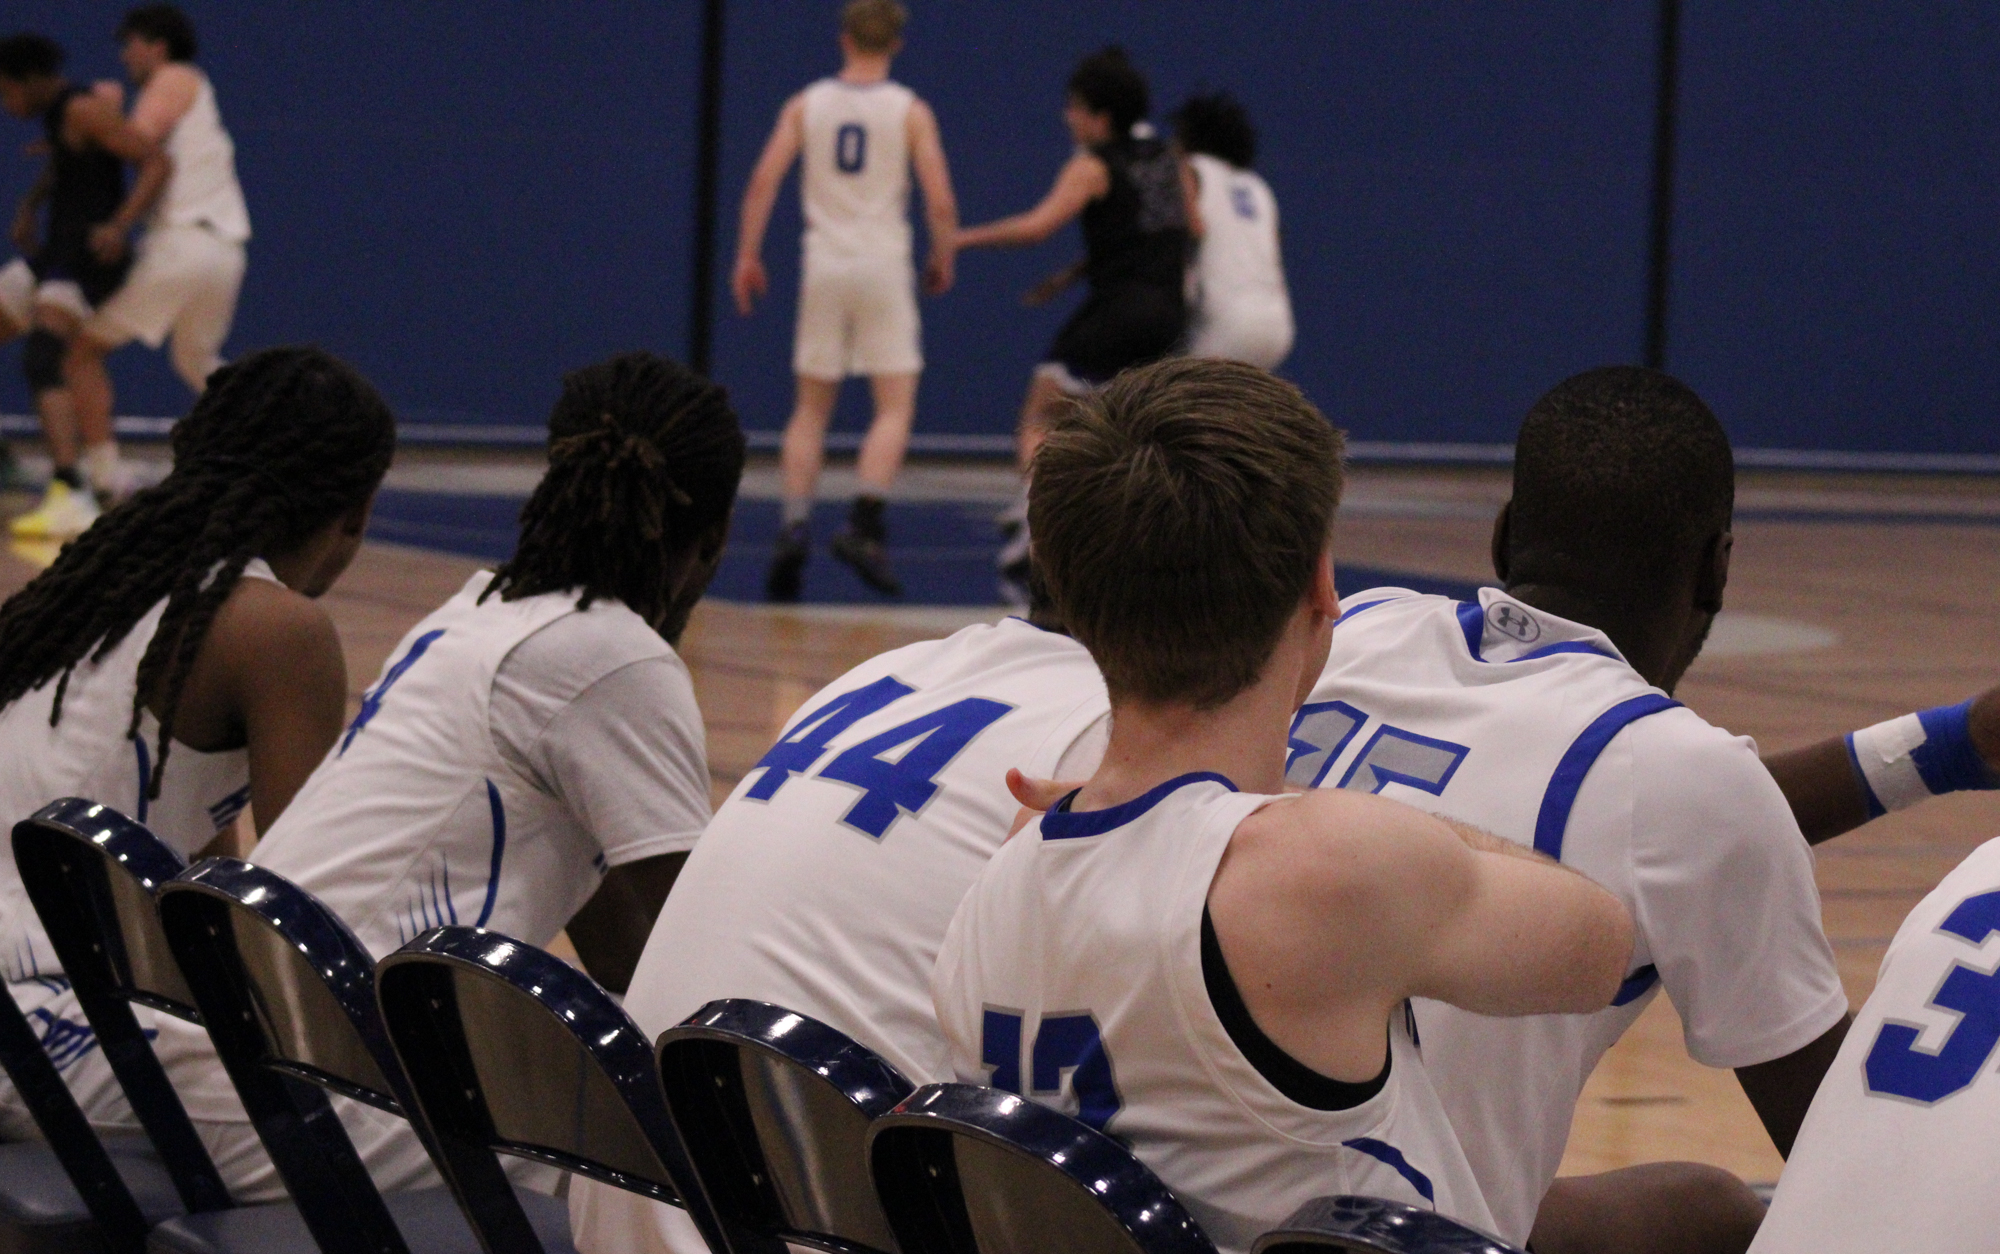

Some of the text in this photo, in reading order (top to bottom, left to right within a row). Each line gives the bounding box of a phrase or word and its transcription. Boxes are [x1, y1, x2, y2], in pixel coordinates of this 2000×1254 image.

[836, 122, 867, 175] 0
[740, 673, 1021, 844] 44
[1859, 886, 2000, 1109] 3
